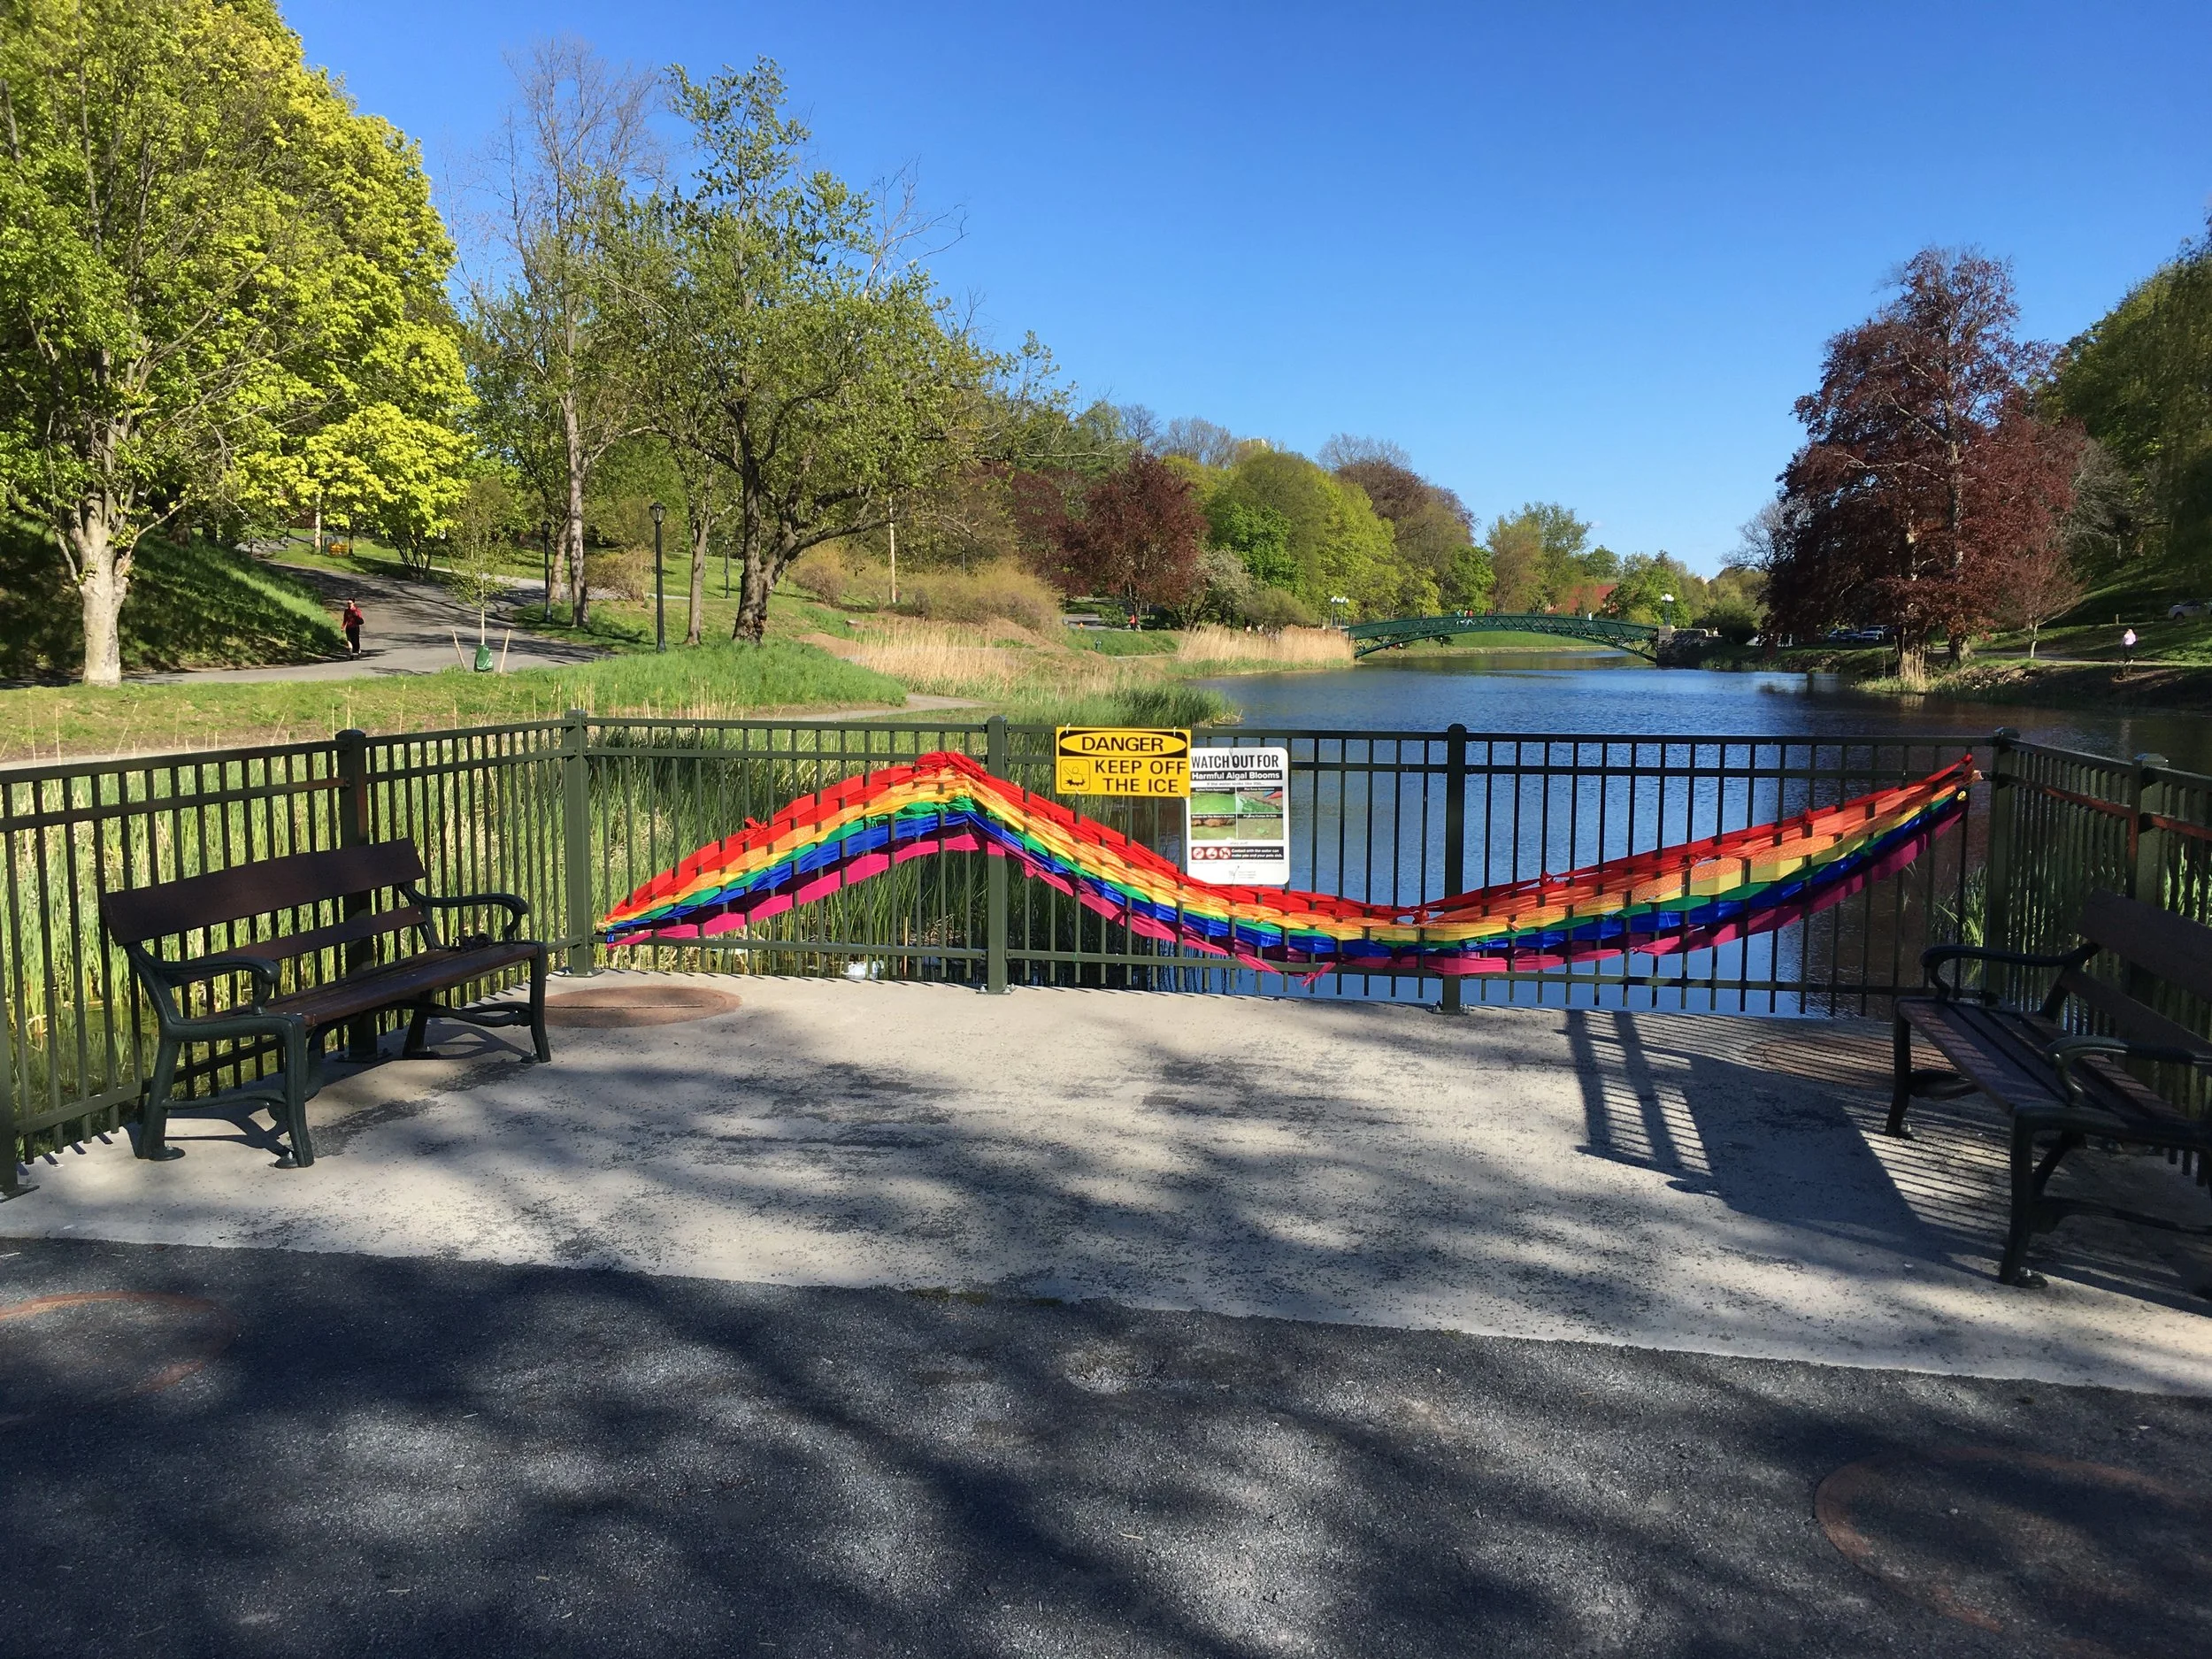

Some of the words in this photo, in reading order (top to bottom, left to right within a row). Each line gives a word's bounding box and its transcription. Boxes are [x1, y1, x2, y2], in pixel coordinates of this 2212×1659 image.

[1081, 736, 1164, 752] DANGER
[1094, 760, 1142, 774] KEEP
[1149, 760, 1187, 775] OFF
[1191, 755, 1230, 769] WATCH
[1232, 755, 1256, 768] OUT
[1257, 754, 1279, 768] FOR
[1226, 772, 1248, 780] Algal
[1102, 778, 1140, 792] THE
[1148, 779, 1179, 793] ICE
